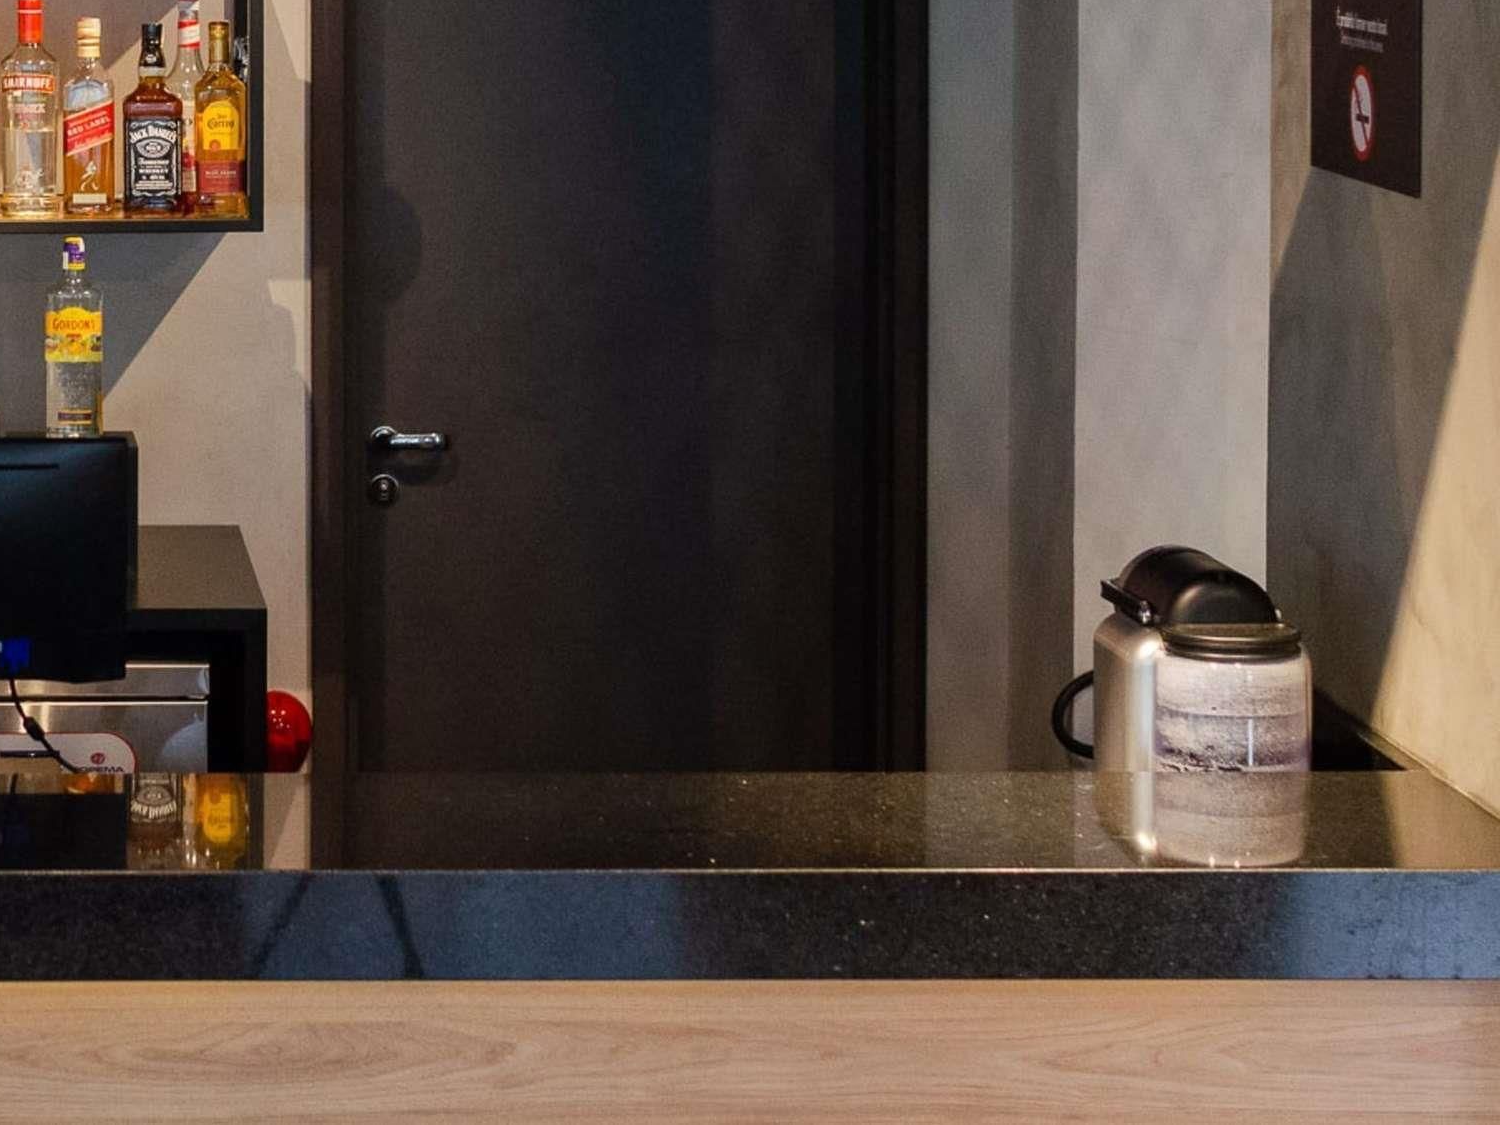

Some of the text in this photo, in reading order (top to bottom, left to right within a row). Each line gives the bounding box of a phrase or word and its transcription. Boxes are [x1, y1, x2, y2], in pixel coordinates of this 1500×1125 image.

[67, 126, 84, 136] RED
[85, 115, 110, 130] LABEL
[129, 128, 148, 144] JACK
